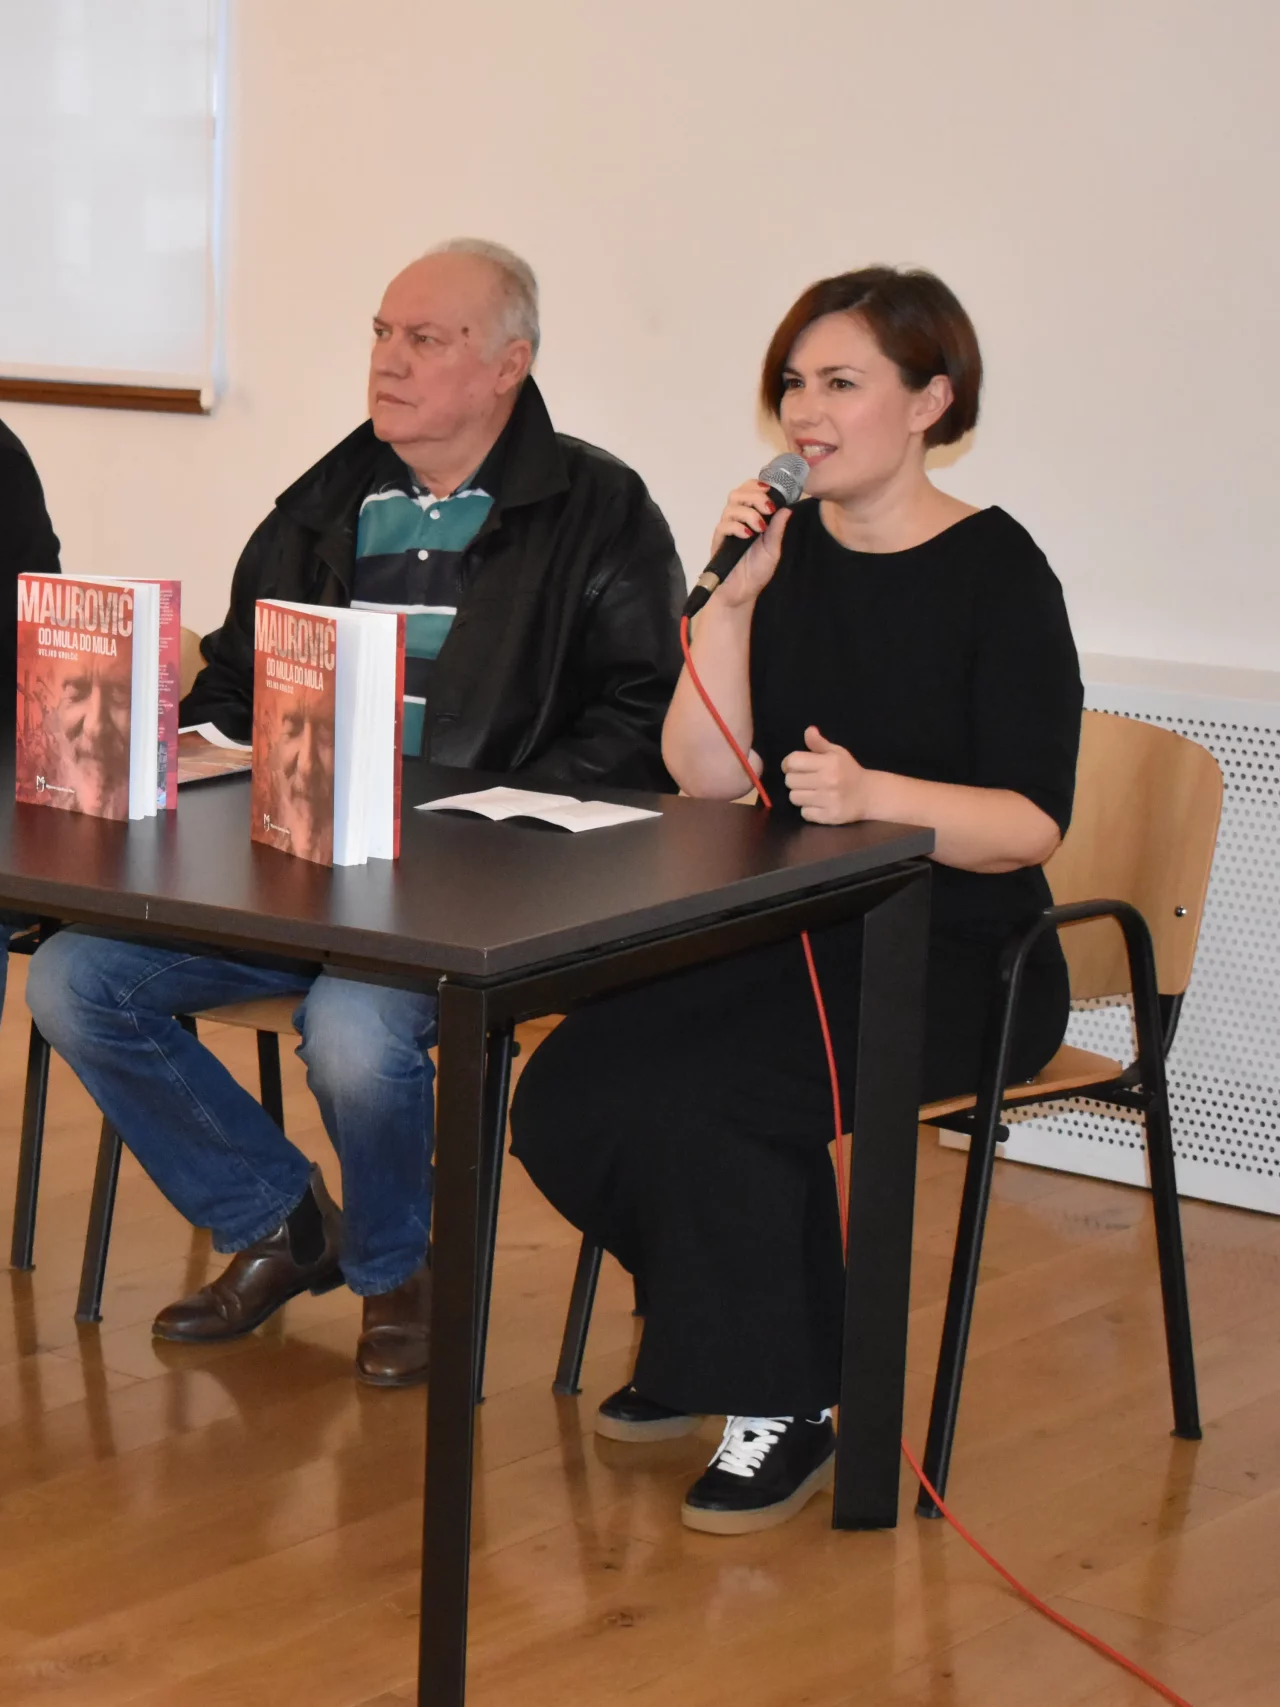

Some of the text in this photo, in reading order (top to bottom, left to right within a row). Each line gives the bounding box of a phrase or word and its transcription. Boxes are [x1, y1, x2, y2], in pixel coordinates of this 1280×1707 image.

[18, 579, 133, 637] MAUROVIĆ
[38, 627, 117, 657] OD MULA DO MULA
[255, 606, 335, 671] MAUROVIĆ
[266, 657, 324, 691] OD MULA DO MULA
